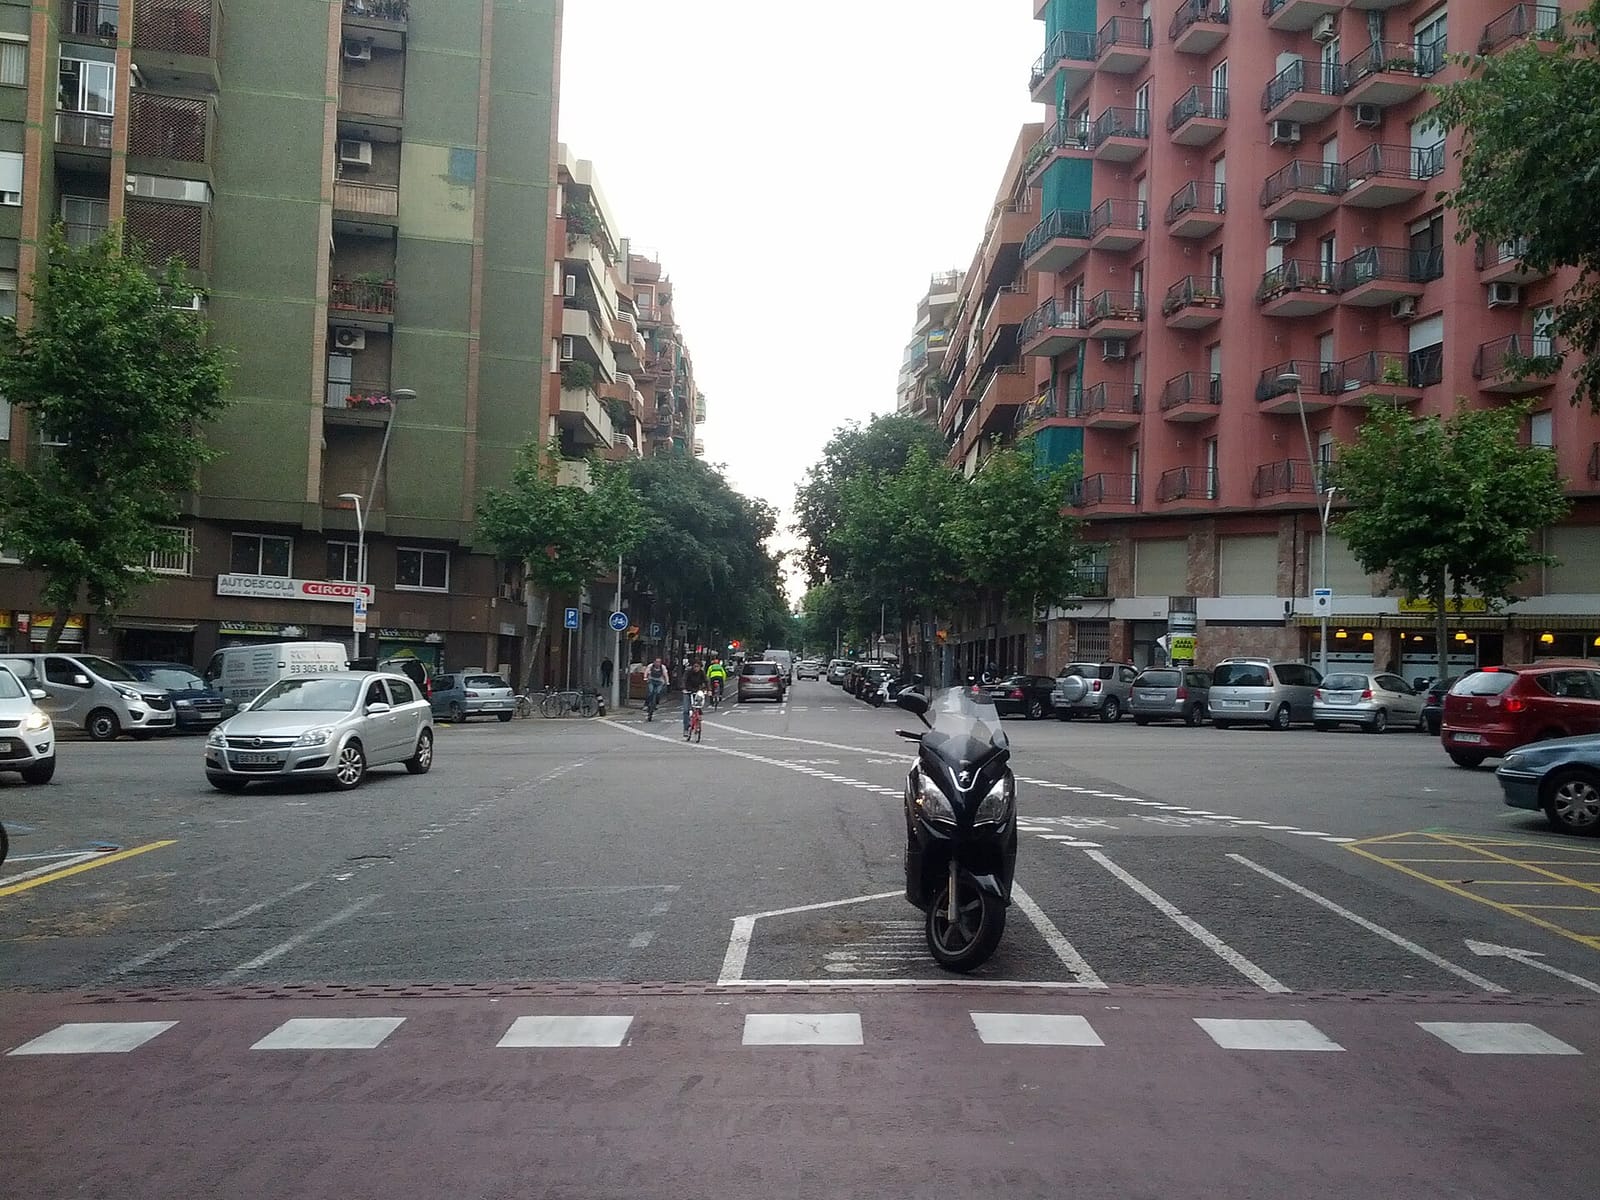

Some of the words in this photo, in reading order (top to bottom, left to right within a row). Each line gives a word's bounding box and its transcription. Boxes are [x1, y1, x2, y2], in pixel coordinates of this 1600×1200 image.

[220, 577, 294, 591] AUTOESCOLA
[568, 611, 575, 619] P
[653, 625, 660, 635] P
[290, 664, 300, 673] 93
[302, 664, 317, 673] 305
